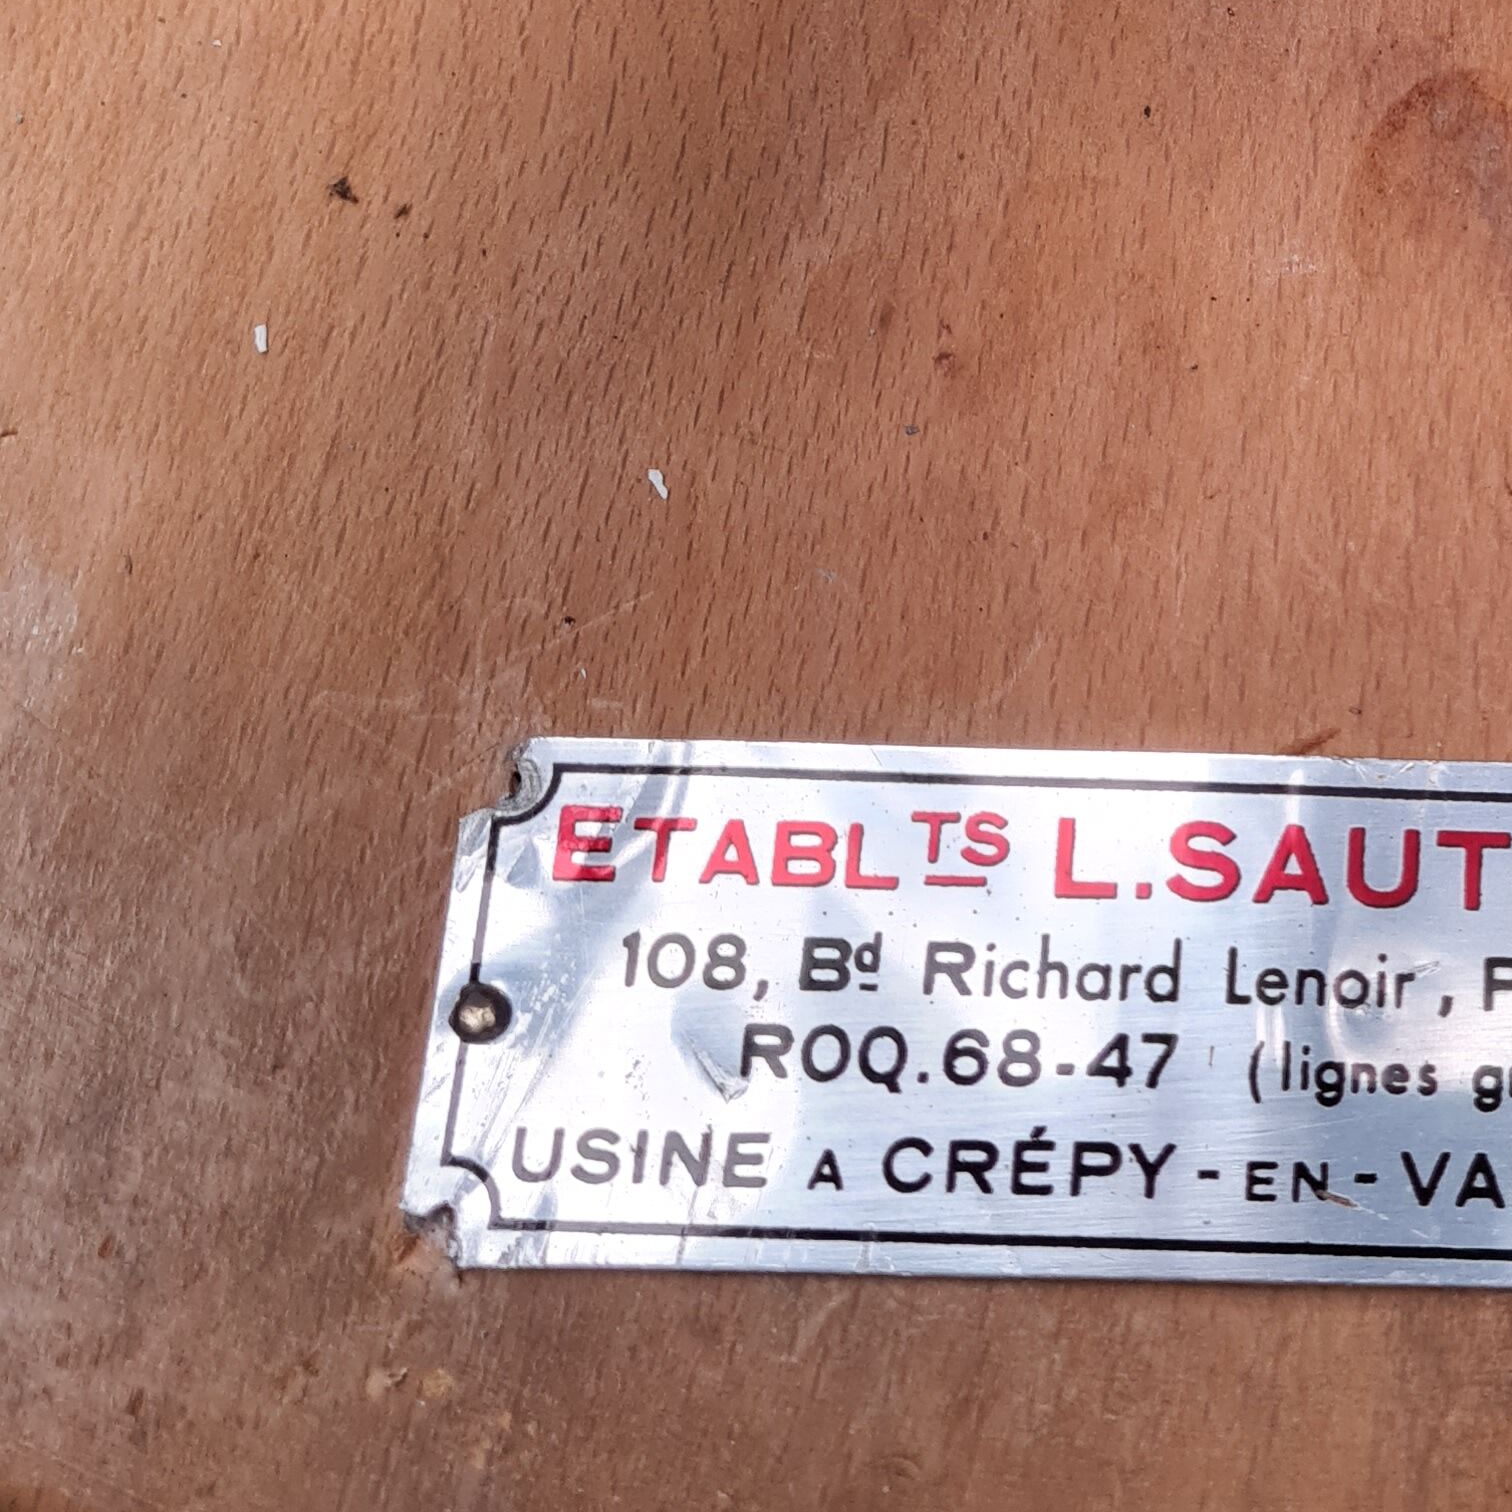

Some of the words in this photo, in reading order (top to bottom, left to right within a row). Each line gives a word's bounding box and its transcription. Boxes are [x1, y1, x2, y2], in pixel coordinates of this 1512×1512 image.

[622, 931, 769, 1002] 108,
[800, 932, 882, 992] Bd
[923, 934, 1180, 1002] Richard
[1248, 1041, 1437, 1107] (lignes
[511, 1126, 770, 1189] USINE
[808, 1150, 842, 1192] A
